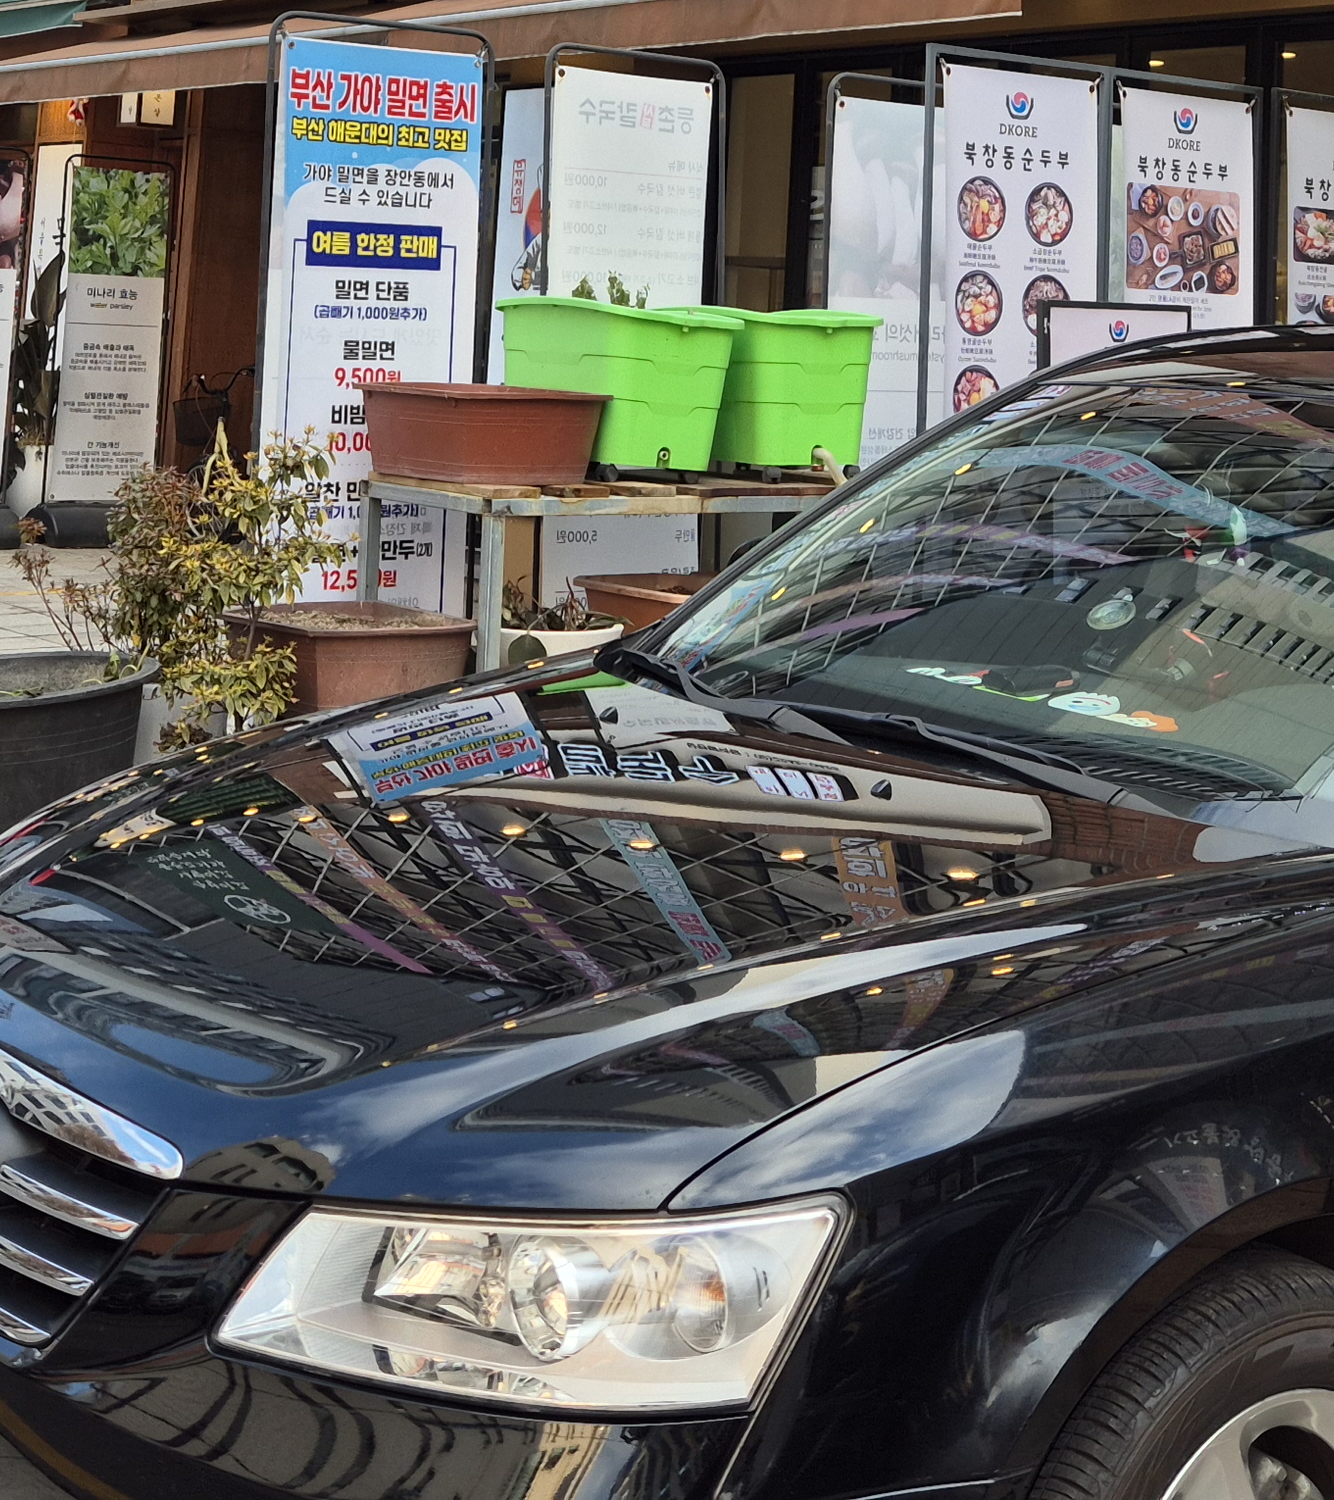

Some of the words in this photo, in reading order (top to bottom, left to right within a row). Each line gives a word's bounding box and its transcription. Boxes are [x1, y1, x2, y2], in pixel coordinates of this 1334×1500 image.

[290, 67, 334, 112] 부산
[338, 72, 381, 115] 가야
[387, 77, 428, 118] 밀면
[433, 81, 478, 124] 출시
[291, 117, 325, 141] 부산
[328, 119, 394, 146] 해운대의
[397, 125, 430, 149] 최고
[434, 128, 468, 152] 맛집
[999, 122, 1038, 140] DKORE
[963, 141, 1070, 172] 북창동순두부
[1167, 138, 1201, 153] DKORE
[303, 163, 333, 182] 가야
[337, 166, 379, 186] 밀면을
[384, 169, 455, 190] 장안동에서
[1137, 154, 1230, 183] 북창동순두부
[324, 187, 352, 206] 드실
[357, 190, 371, 206] 수
[376, 190, 433, 209] 있습니다
[312, 230, 351, 255] 여름
[356, 233, 395, 257] 한정
[400, 234, 438, 258] 판매
[87, 287, 115, 299] 미나리
[119, 289, 138, 300] 효능
[335, 280, 369, 299] 밀면
[375, 280, 409, 301] 단품
[343, 339, 396, 362] 물밀면
[334, 367, 402, 389] 9,500원
